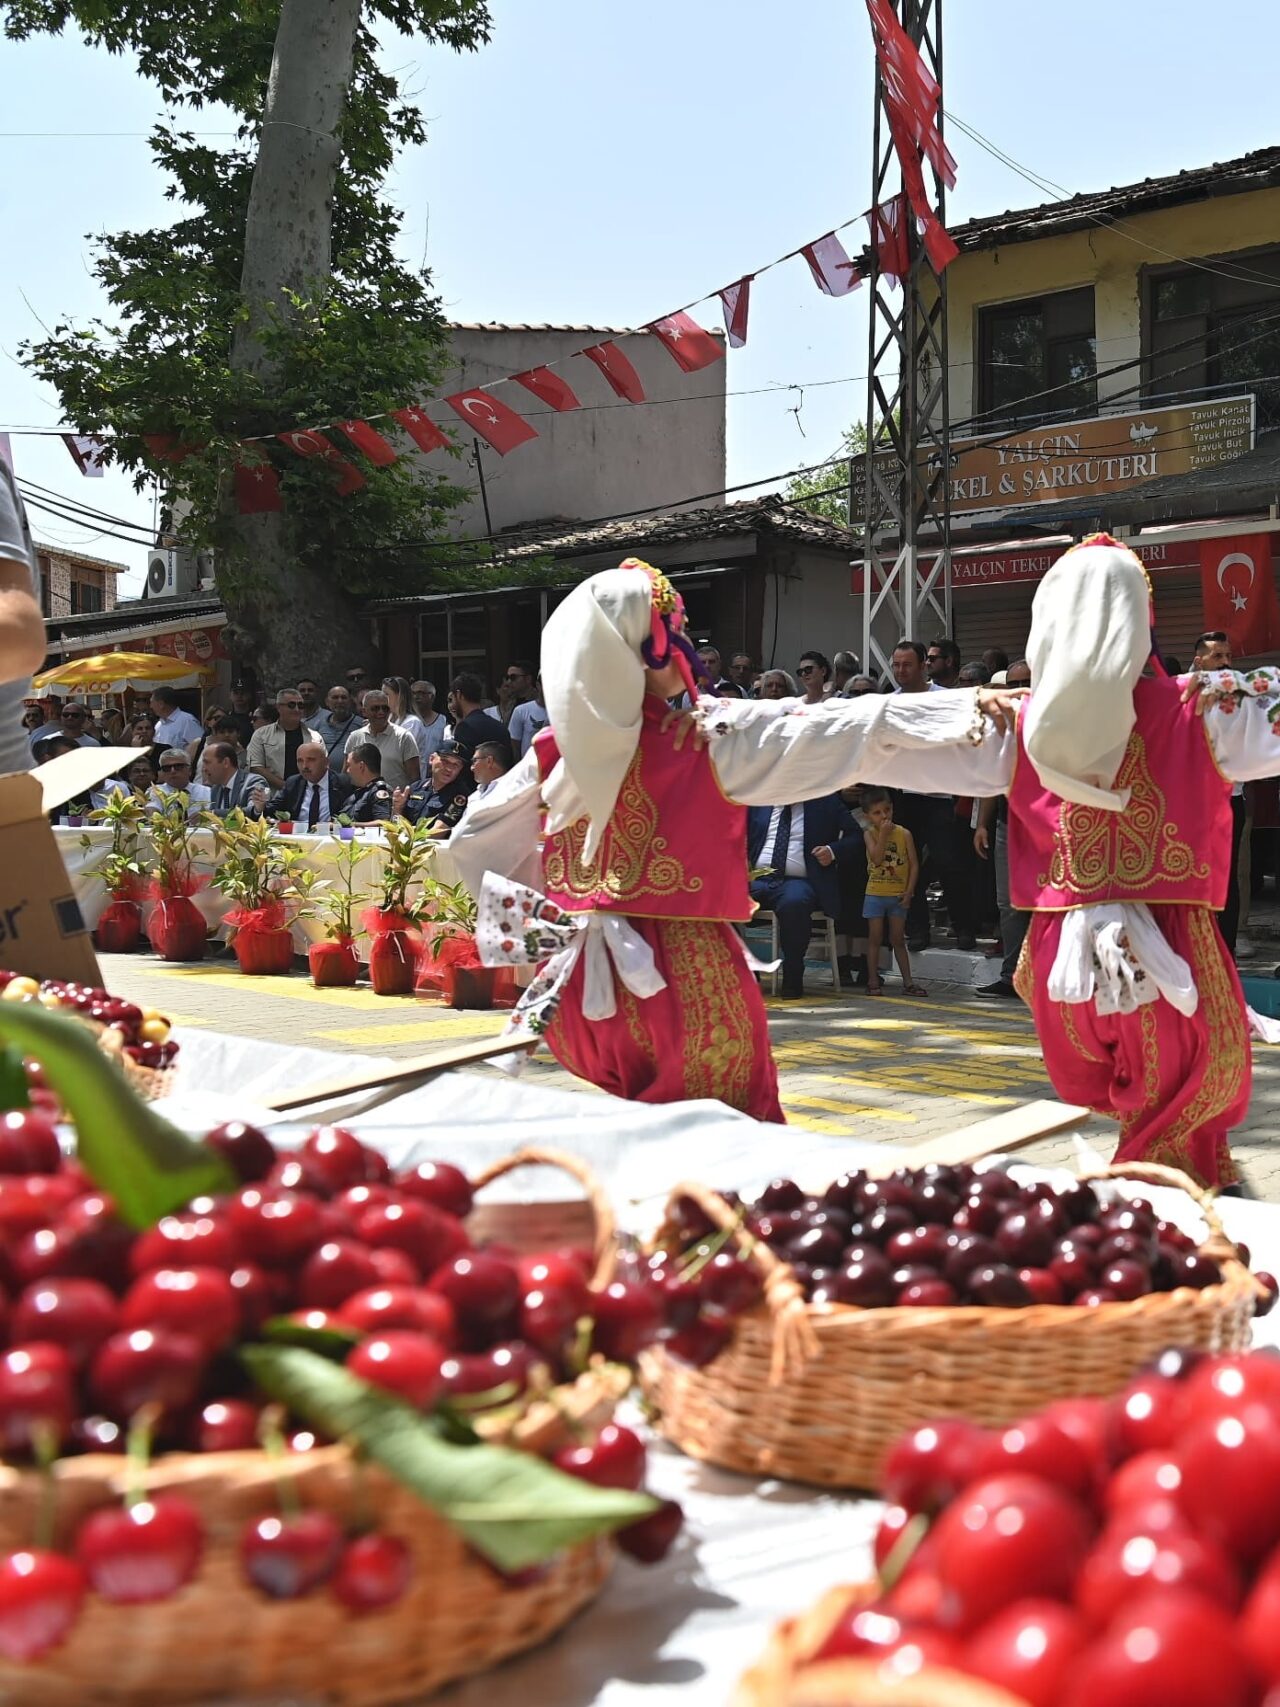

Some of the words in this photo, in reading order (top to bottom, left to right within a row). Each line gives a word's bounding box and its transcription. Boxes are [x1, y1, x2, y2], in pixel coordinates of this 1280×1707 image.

[1191, 409, 1217, 419] Tavuk
[1222, 405, 1248, 415] Kanat
[1189, 421, 1215, 431] Tavuk
[1219, 416, 1250, 427] Pirzola
[1194, 432, 1219, 441] Tavuk
[995, 433, 1082, 466] YALÇIN
[1198, 442, 1222, 452] Tavuk
[1226, 439, 1243, 449] But
[1190, 454, 1215, 464] Tavuk
[1220, 450, 1248, 460] Göğü
[998, 473, 1017, 495] &
[1022, 447, 1159, 497] ŞARKÜTERİ
[952, 560, 1006, 580] YALÇIN
